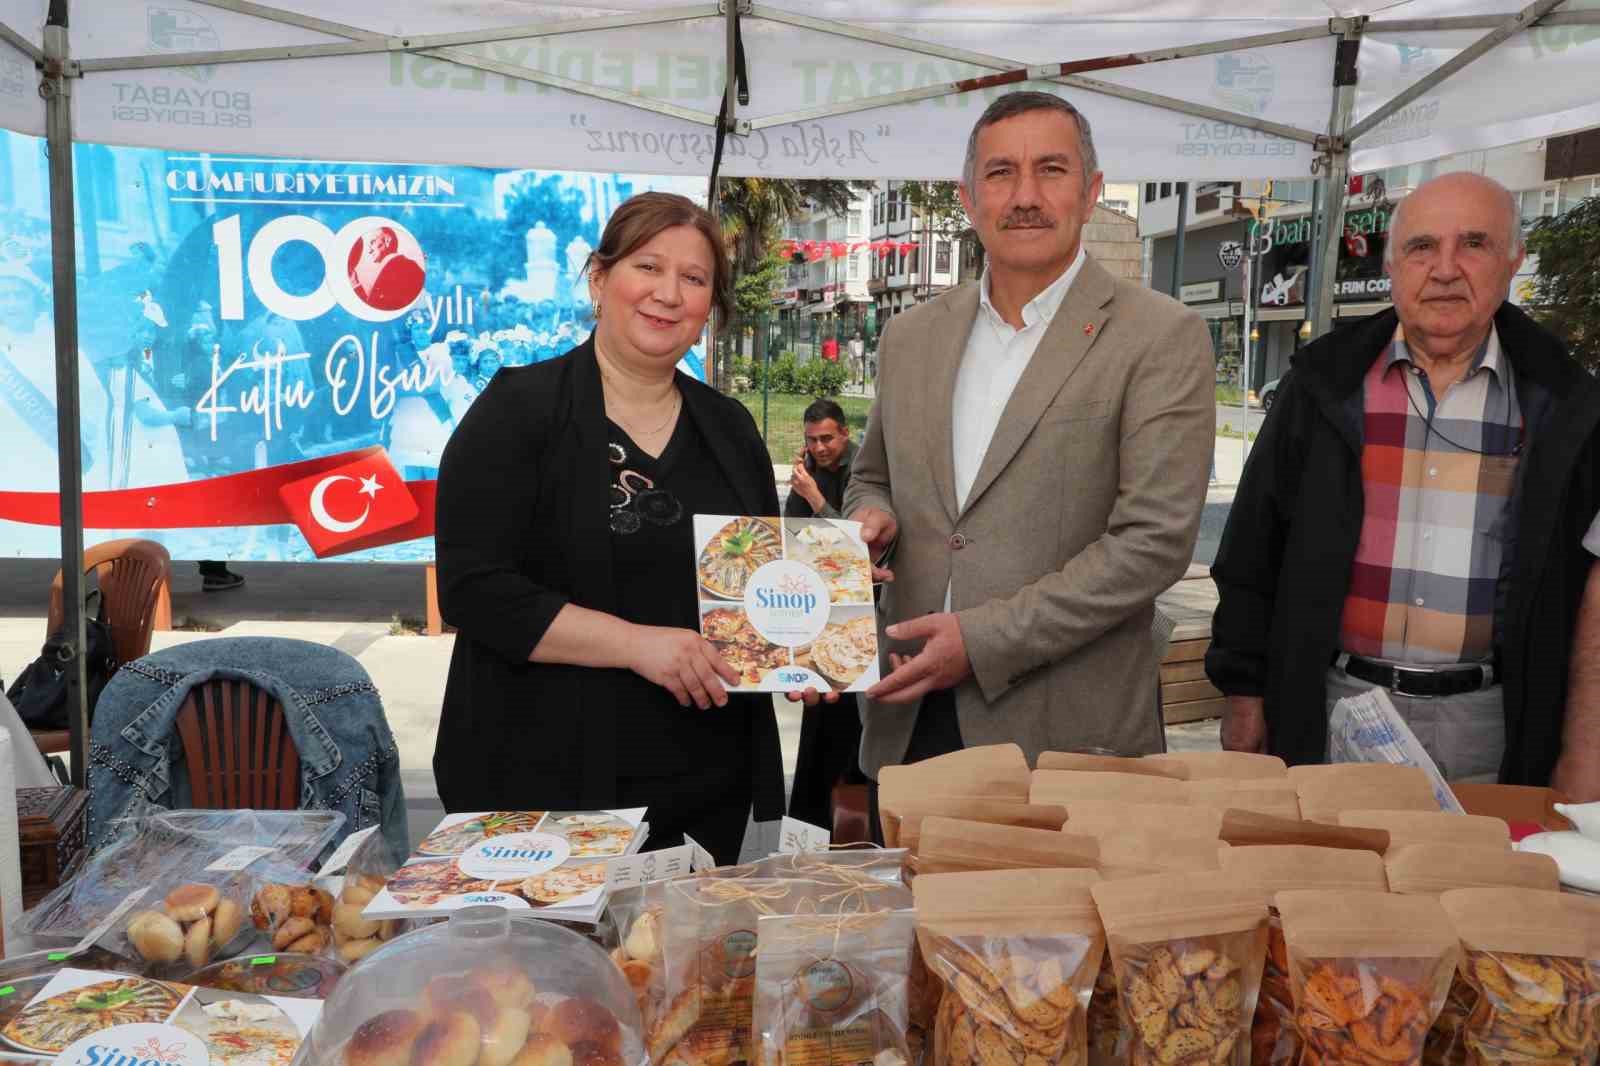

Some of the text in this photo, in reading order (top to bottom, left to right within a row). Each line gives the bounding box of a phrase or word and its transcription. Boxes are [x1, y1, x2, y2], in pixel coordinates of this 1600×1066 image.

[166, 169, 456, 196] CUMHURİYETİMİZİN
[212, 213, 426, 322] 100
[1341, 280, 1366, 294] FUN
[195, 331, 455, 441] Kutlu Olsun
[755, 587, 817, 614] Sinop
[478, 846, 553, 862] Sinop
